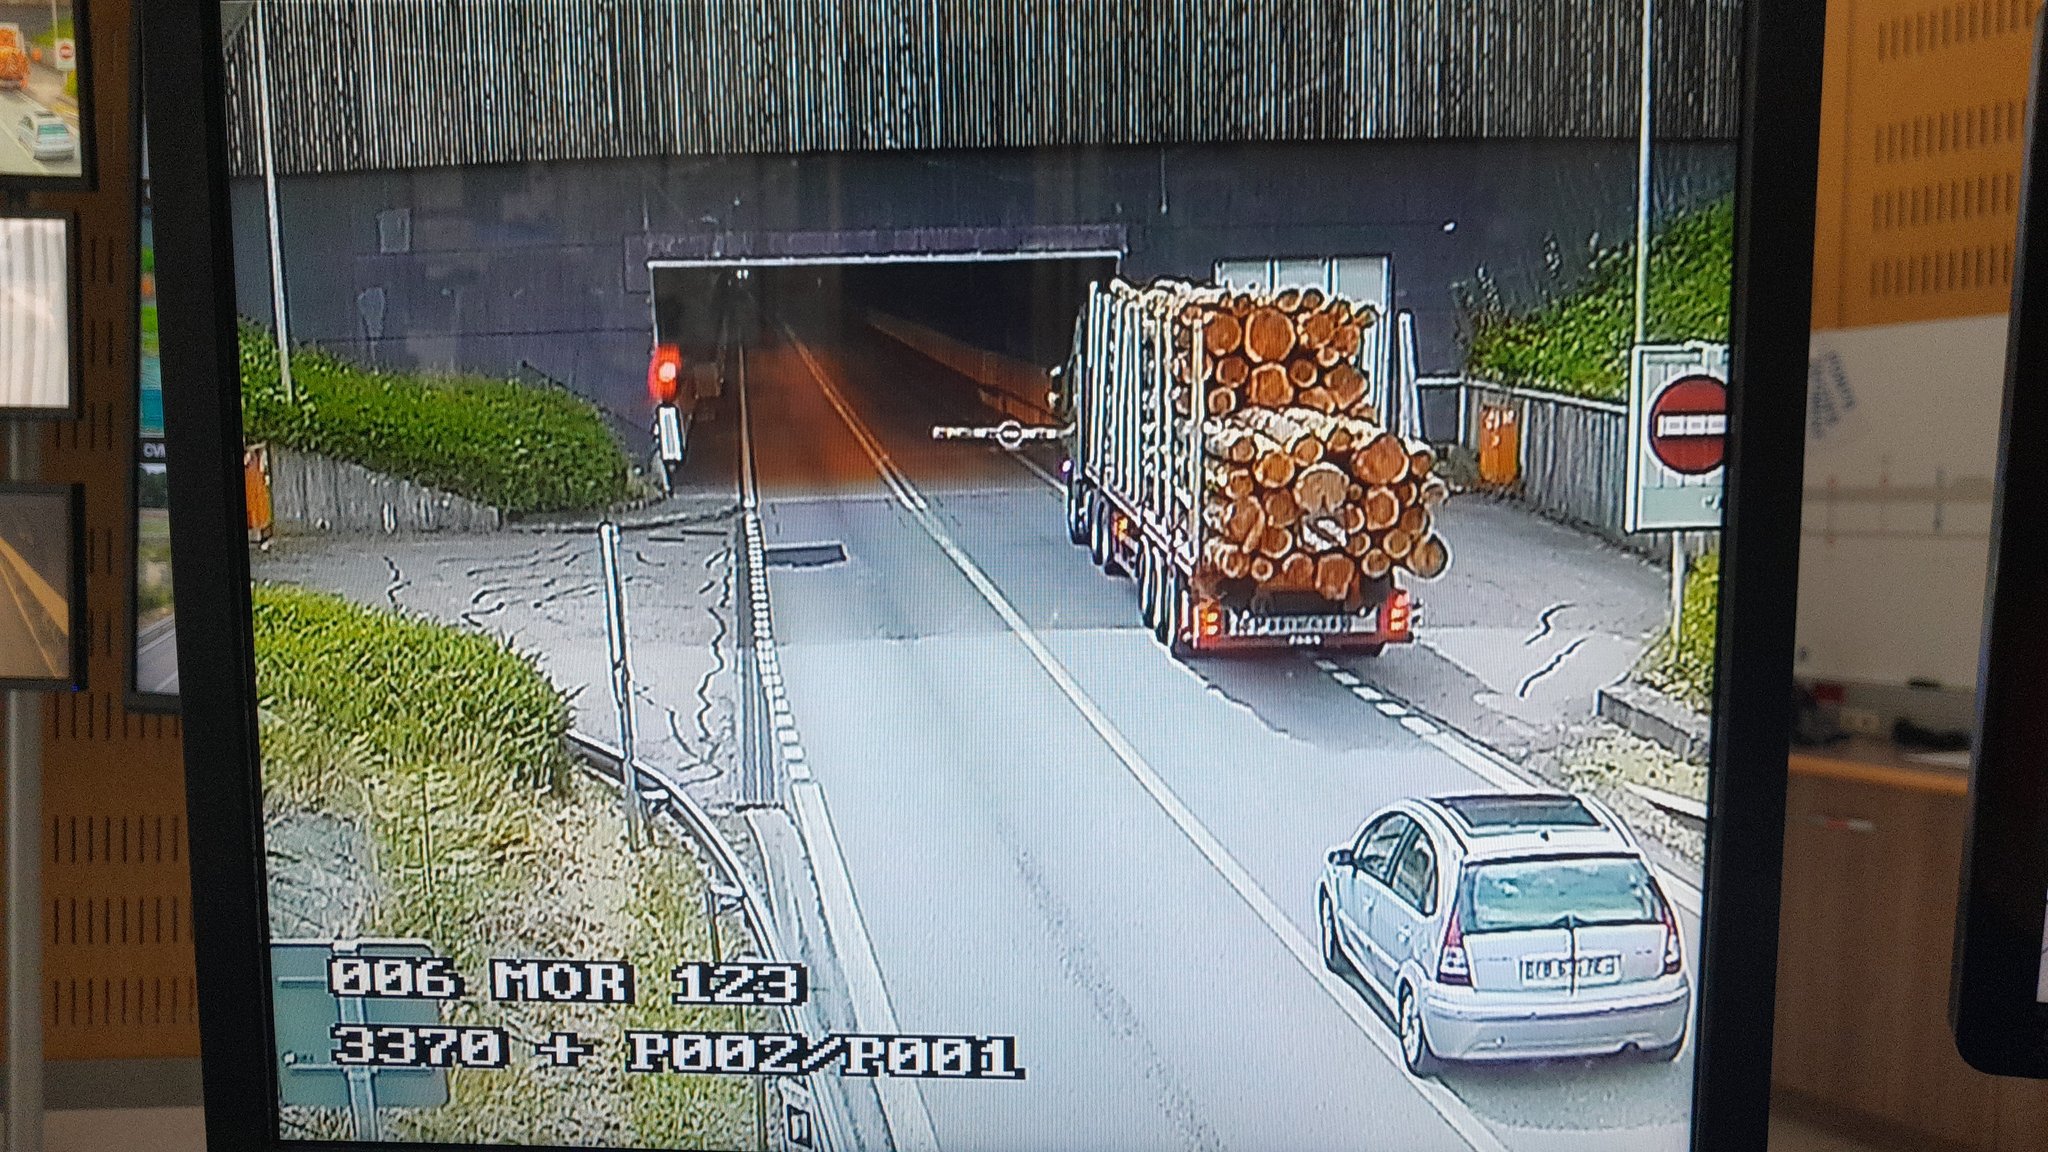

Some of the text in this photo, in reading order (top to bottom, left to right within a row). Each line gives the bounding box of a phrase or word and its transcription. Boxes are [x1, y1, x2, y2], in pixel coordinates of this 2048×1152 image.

[331, 960, 798, 1003] 006 MOR 123
[334, 1027, 501, 1066] 3370
[630, 1032, 1016, 1076] P002/P001
